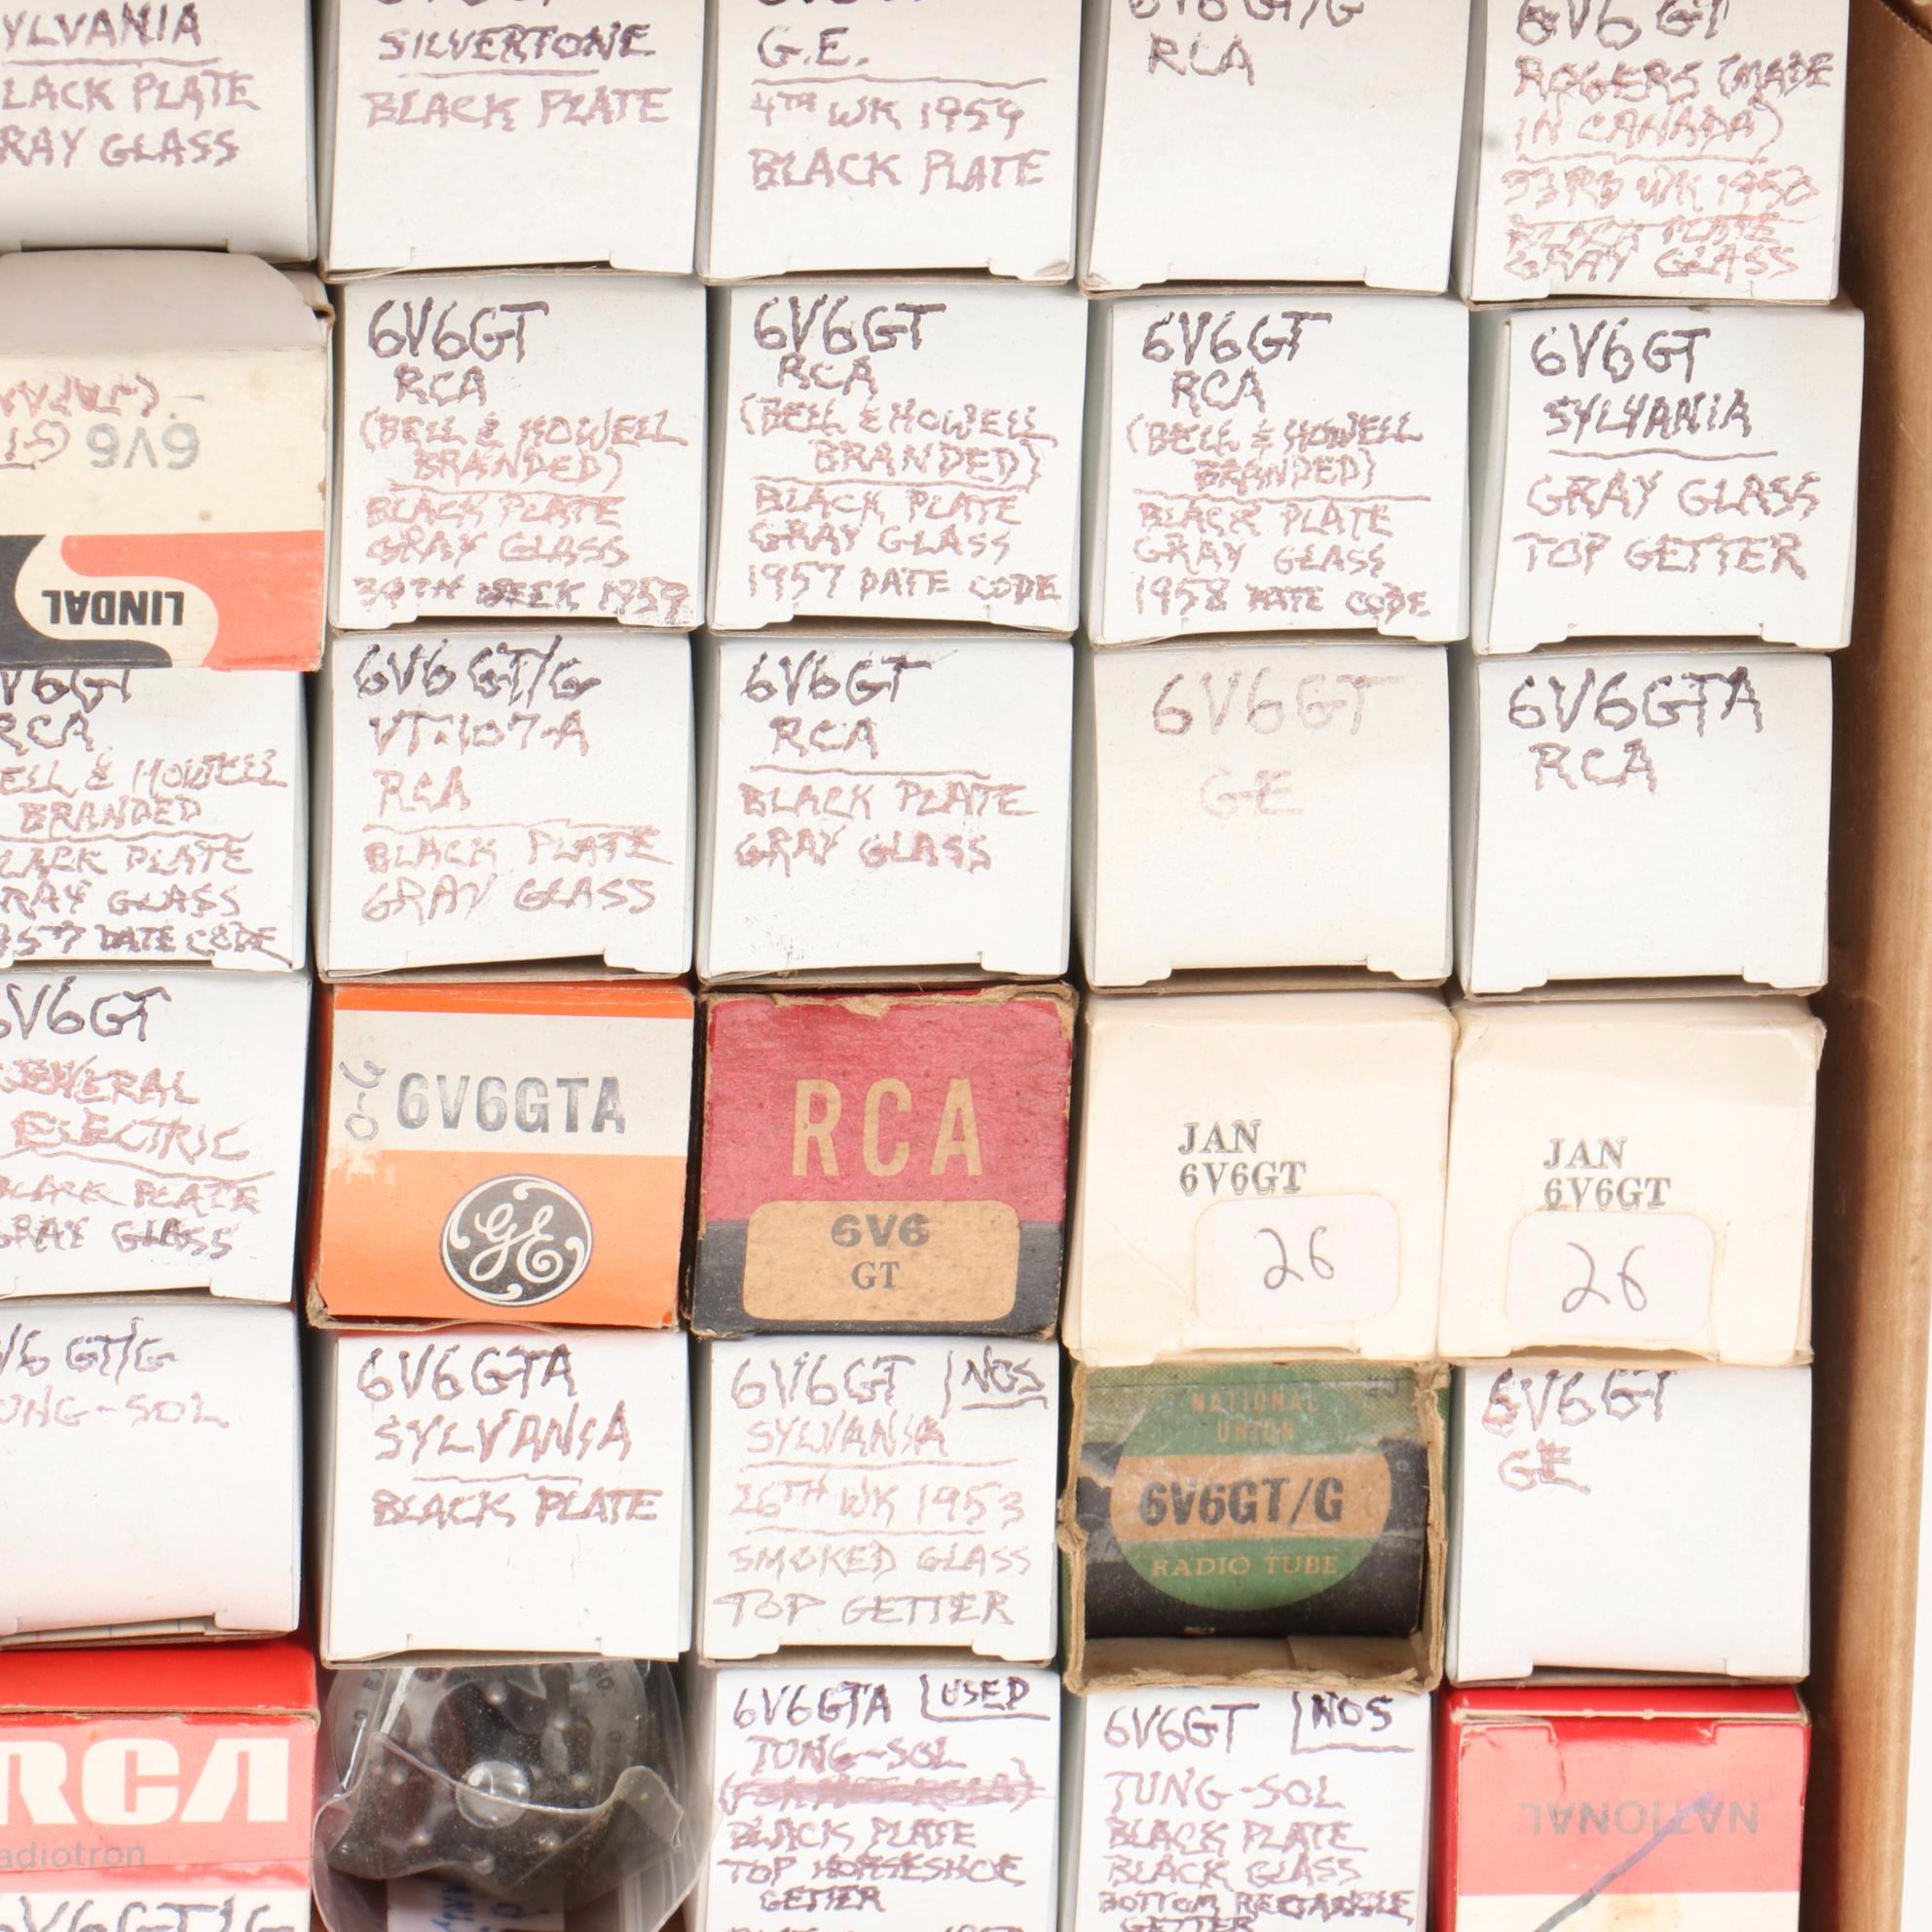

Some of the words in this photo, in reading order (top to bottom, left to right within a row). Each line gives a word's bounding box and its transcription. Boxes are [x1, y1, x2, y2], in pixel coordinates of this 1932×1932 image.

[378, 20, 656, 64] SILVERTONE
[757, 26, 870, 68] G.E.
[1146, 32, 1255, 86] RCA
[132, 70, 261, 121] PLATE
[360, 90, 521, 131] BLACK
[538, 86, 673, 128] PLATE
[920, 95, 1024, 140] 1959
[99, 128, 240, 167] GLASS
[748, 146, 902, 191] BLACK
[919, 149, 1051, 195] PLATE
[1654, 242, 1799, 283] GLASS
[368, 296, 549, 363] 6V6GT
[754, 293, 947, 354] 6V6GT
[1141, 310, 1332, 365] 6V6GT
[1530, 316, 1711, 384] 6V6GT
[394, 361, 487, 406] RCA
[778, 353, 877, 395] RCA
[1170, 366, 1266, 418] RCA
[87, 423, 200, 470] 6V6
[906, 488, 1022, 525] PLATE
[1526, 467, 1664, 520] GRAY
[1678, 470, 1822, 521] GLASS
[1280, 501, 1394, 541] PLATE
[499, 532, 630, 568] GLASS
[877, 524, 1012, 565] GLASS
[1512, 531, 1613, 576] TOP
[1623, 532, 1808, 580] GETTER
[748, 561, 846, 601] 1957
[968, 573, 1061, 605] CODE
[41, 589, 185, 626] LINDAL
[741, 650, 933, 707] 6V6GT
[1153, 666, 1404, 735] 6V6GT
[1508, 666, 1764, 738] 6V6GTA
[769, 716, 878, 761] RCA
[1528, 738, 1657, 793] RCA
[373, 765, 470, 818] RCA
[738, 783, 874, 820] BLACK
[896, 779, 1040, 818] PLATE
[1200, 767, 1305, 819] GE
[363, 836, 498, 873] BLACK
[529, 828, 675, 866] PLATE
[736, 824, 846, 878] GRAY
[858, 830, 991, 874] GLASS
[108, 882, 241, 917] GLASS
[361, 873, 499, 925] GRAY
[514, 875, 655, 914] GLASS
[94, 924, 176, 952] DATE
[396, 1072, 627, 1133] 6V6GTA
[792, 1078, 984, 1176] RCA
[1177, 1119, 1262, 1155] JAN
[1542, 1136, 1627, 1170] JAN
[1179, 1160, 1307, 1196] 6V6GT
[1543, 1176, 1672, 1211] 6V6GT
[112, 1217, 242, 1260] GLASS
[831, 1213, 930, 1247] 6V6
[850, 1261, 901, 1290] GT
[1253, 1226, 1335, 1290] 26
[1561, 1242, 1648, 1314] 26
[357, 1344, 577, 1401] 6V6GTA
[731, 1352, 916, 1408] 6V6GT
[1190, 1387, 1317, 1414] NATIONAL
[1481, 1367, 1678, 1438] 6V6GT
[374, 1400, 632, 1465] SYLVANIA
[746, 1409, 948, 1457] SYLVANIA
[1216, 1418, 1293, 1444] UNION
[1498, 1438, 1591, 1495] GE
[372, 1489, 515, 1529] BLACK
[536, 1486, 664, 1527] PLATE
[728, 1473, 828, 1518] 26TH
[839, 1476, 899, 1528] WK
[917, 1481, 1025, 1530] 1953
[1139, 1476, 1344, 1530] 6V6GT/G
[727, 1541, 898, 1582] SMOKED
[917, 1542, 1031, 1577] GLASS
[1150, 1557, 1251, 1578] RADIO
[1265, 1555, 1337, 1576] TUBE
[713, 1588, 827, 1627] TOP
[842, 1590, 1014, 1625] GETTER
[733, 1681, 891, 1728] 6V6GTA
[941, 1676, 1030, 1711] USED
[1104, 1703, 1260, 1753] 6V6GT
[1312, 1690, 1393, 1731] NOS
[0, 1737, 289, 1826] RCA
[1103, 1767, 1346, 1815] TUNG-SOL
[727, 1816, 857, 1851] BLACK
[867, 1817, 977, 1850] PLATE
[1105, 1816, 1229, 1857] BLACK
[1243, 1819, 1368, 1853] PLATE
[1518, 1800, 1760, 1836] NATIONAL
[717, 1856, 797, 1886] TOP
[1103, 1854, 1234, 1891] BLACK
[1245, 1852, 1362, 1888] GLASS
[760, 1885, 886, 1912] GETTER
[1098, 1890, 1221, 1914] BOTTOM
